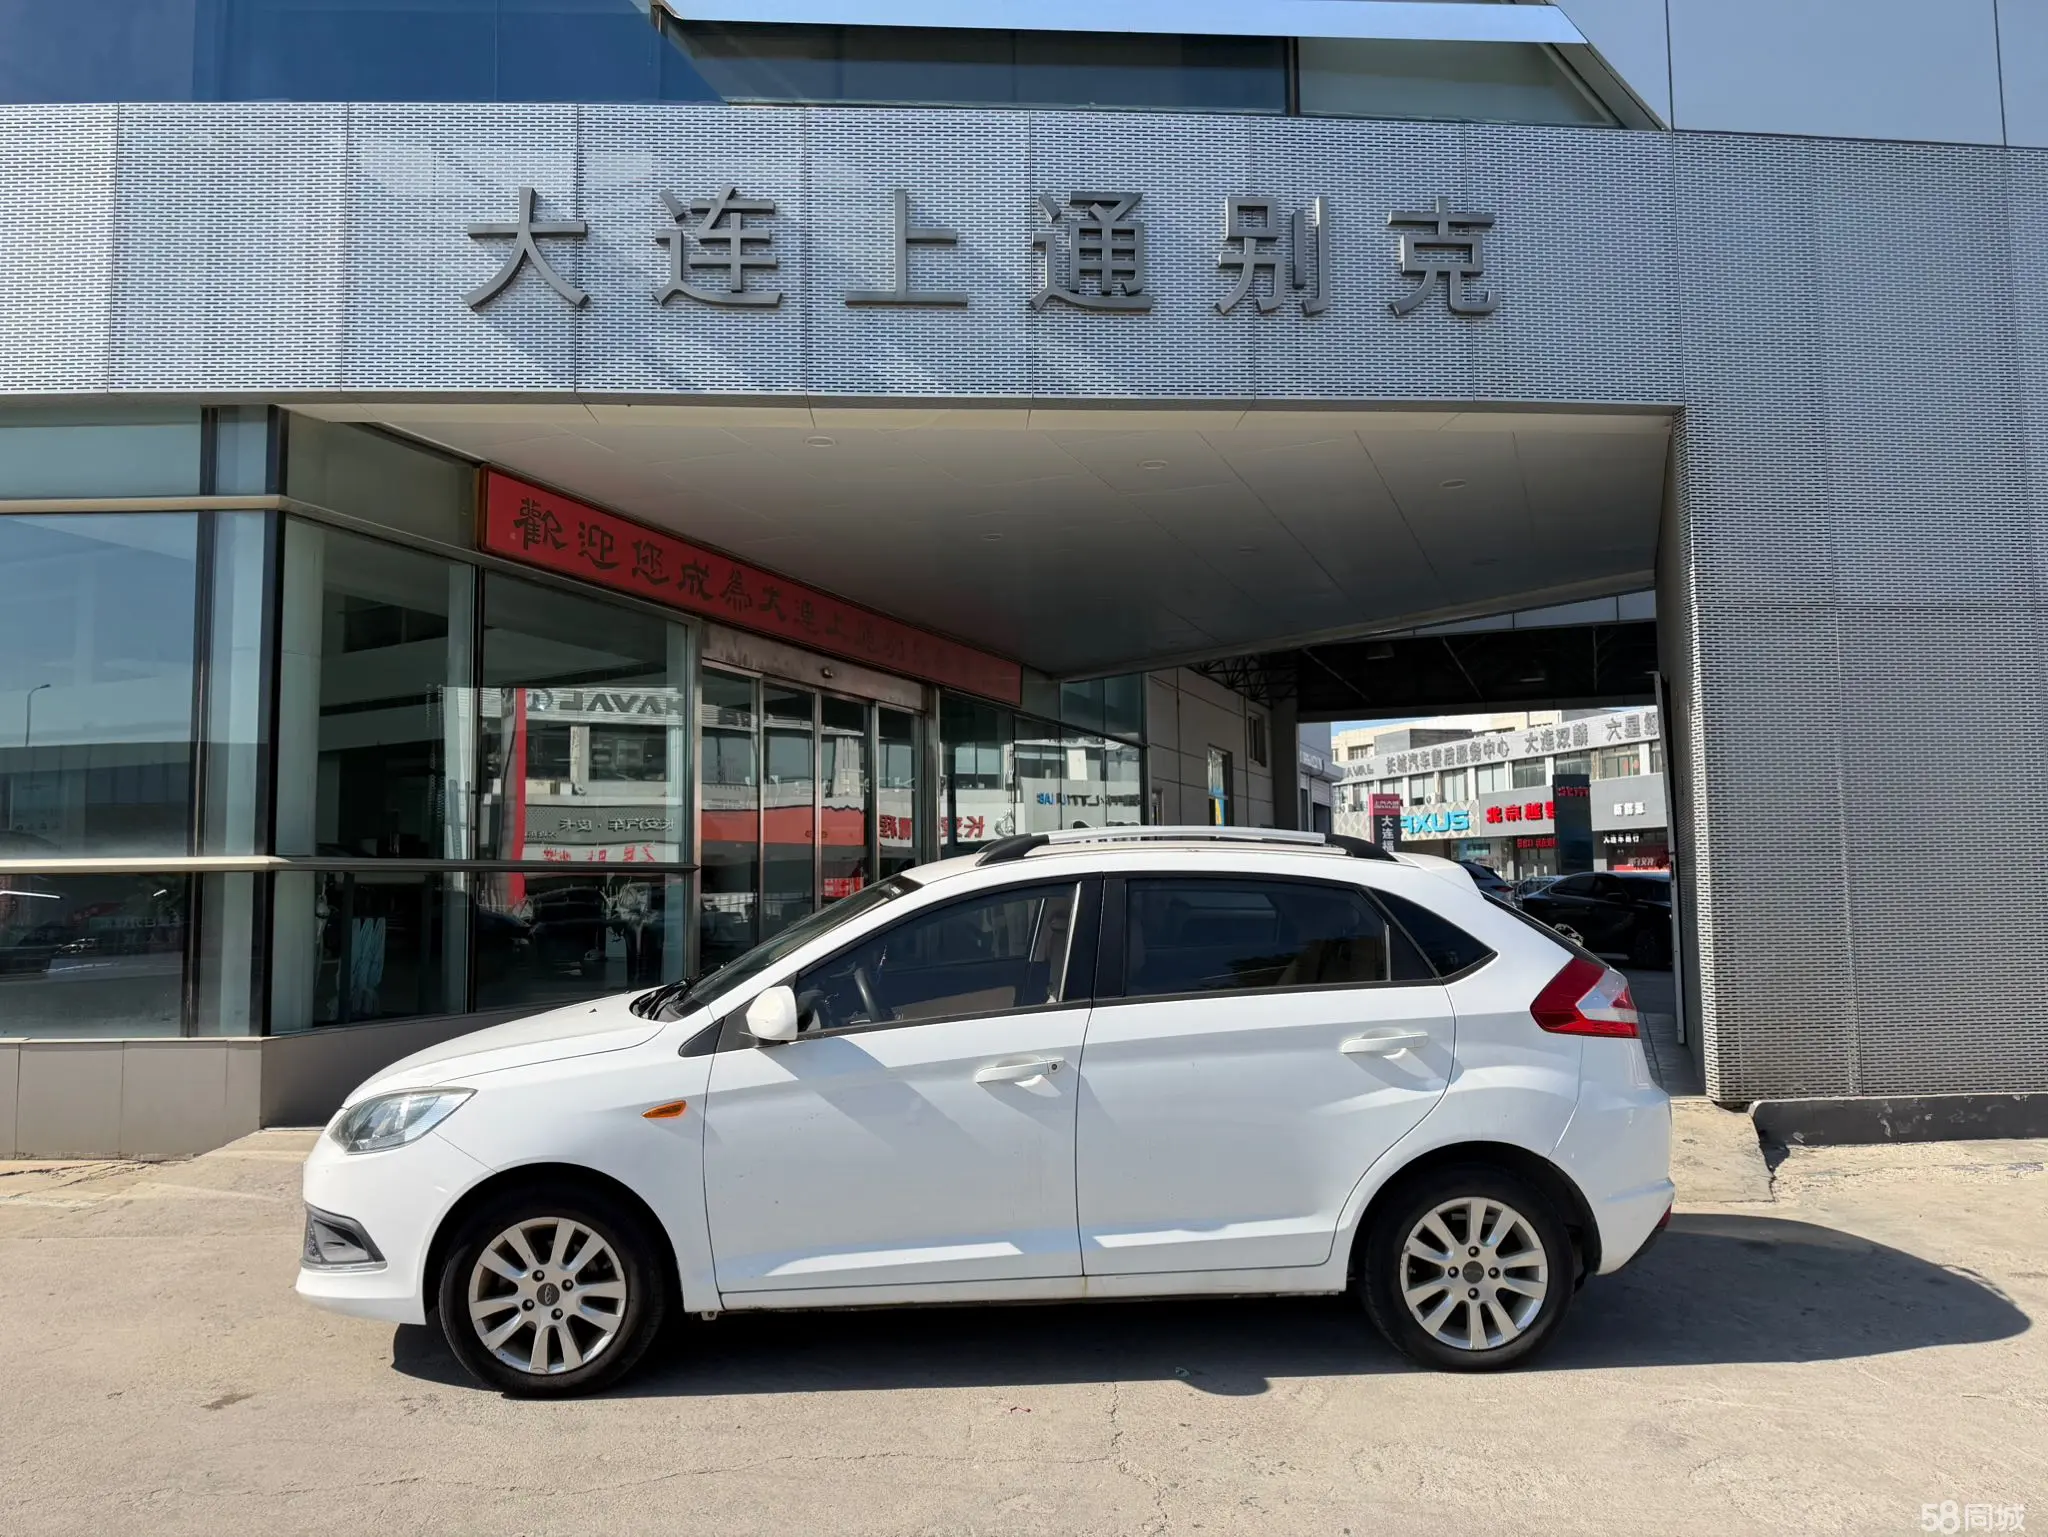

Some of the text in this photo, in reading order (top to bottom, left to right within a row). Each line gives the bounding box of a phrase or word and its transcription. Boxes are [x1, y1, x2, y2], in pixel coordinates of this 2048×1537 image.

[464, 187, 1502, 316] 大连上通别克
[1346, 764, 1374, 778] AVAL
[1385, 735, 1510, 775] 长城汽车售后服务中心
[1401, 809, 1470, 834] AXUS
